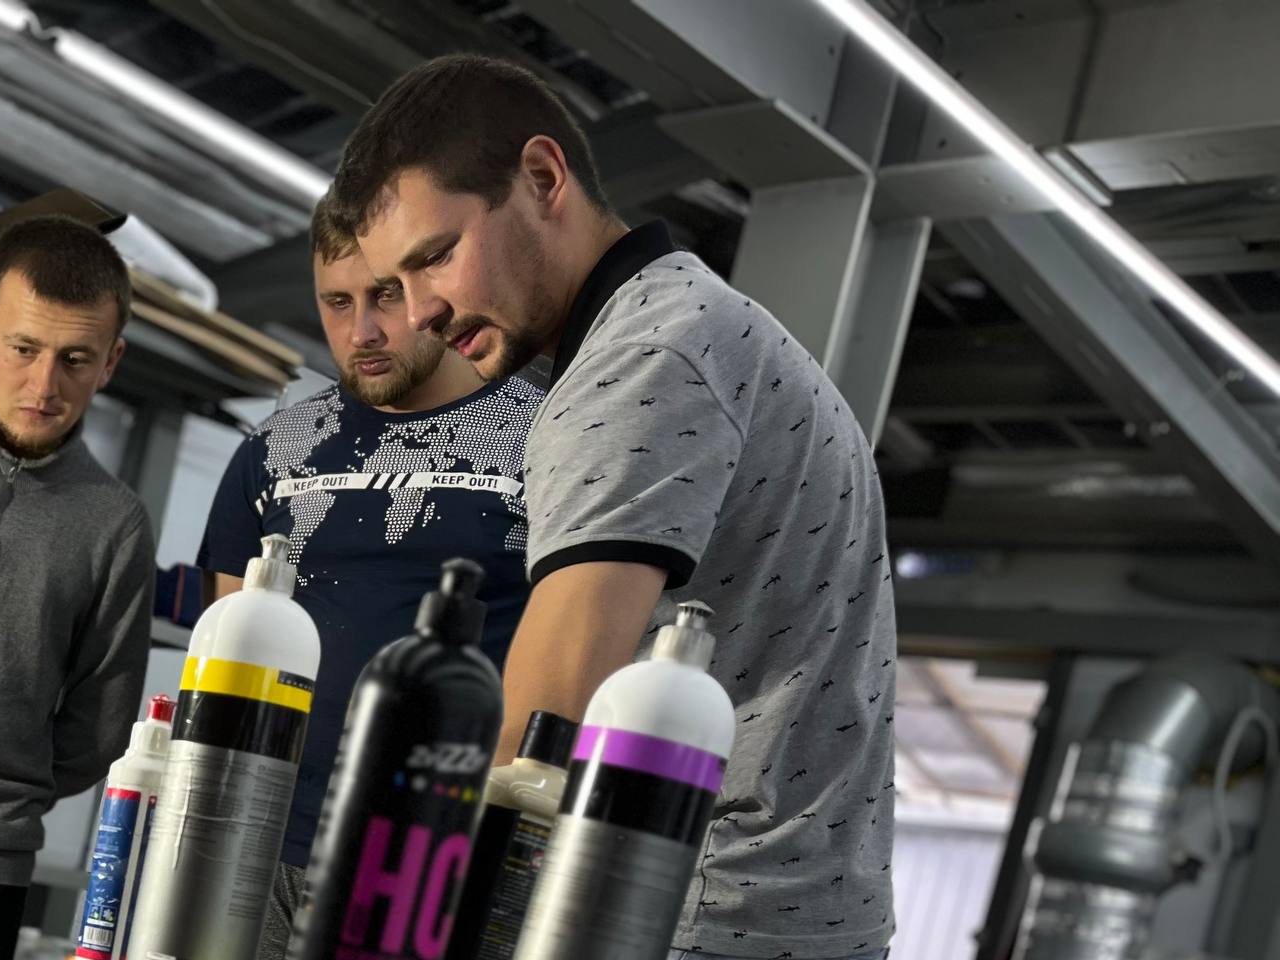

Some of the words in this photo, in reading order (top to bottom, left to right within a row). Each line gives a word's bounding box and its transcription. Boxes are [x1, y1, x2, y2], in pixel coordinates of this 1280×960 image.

[293, 477, 319, 493] KEEP
[321, 476, 348, 488] OUT!
[431, 474, 465, 486] KEEP
[469, 477, 498, 489] OUT!
